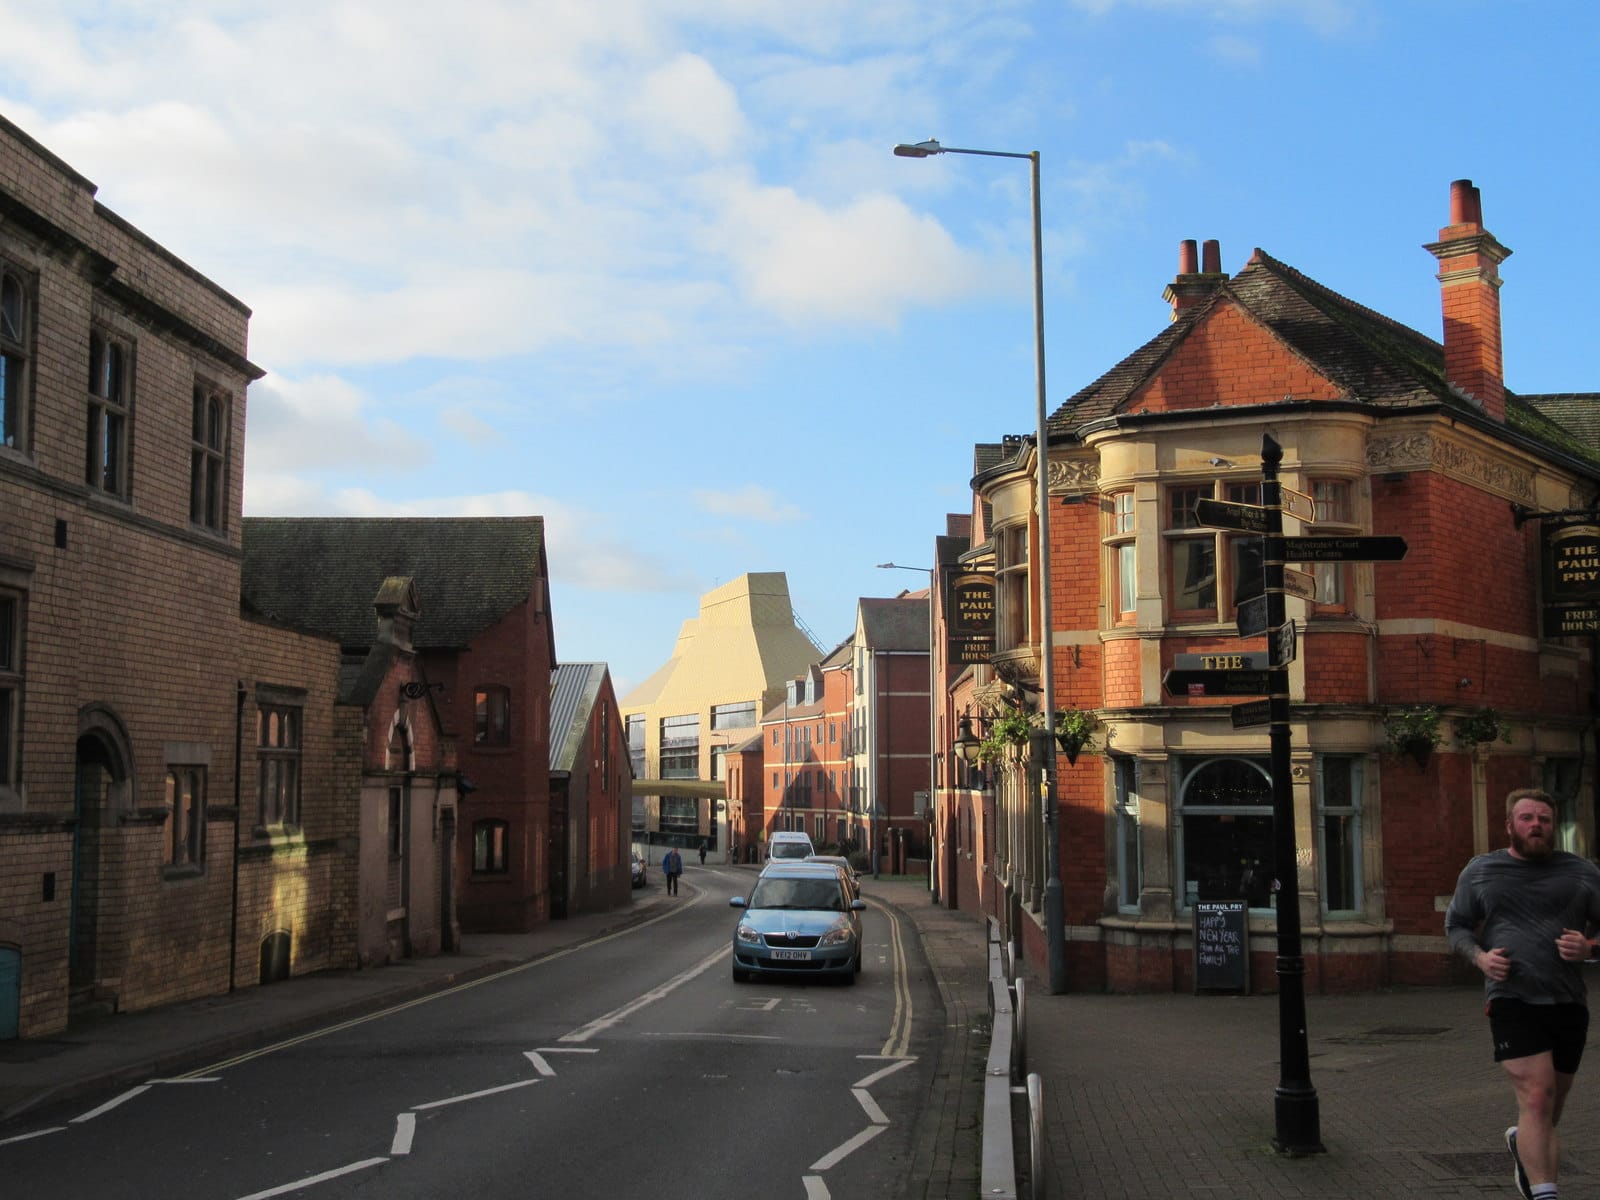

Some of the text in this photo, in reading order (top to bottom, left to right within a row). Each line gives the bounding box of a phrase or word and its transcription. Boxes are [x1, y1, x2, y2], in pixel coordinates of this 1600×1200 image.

[1335, 540, 1359, 549] Court
[1286, 550, 1314, 559] Health
[1563, 546, 1598, 556] THE
[1558, 558, 1600, 569] PAUL
[1562, 571, 1599, 582] PRY
[963, 591, 991, 599] THE
[959, 602, 995, 610] PAUL
[963, 612, 992, 621] PRY
[1565, 610, 1597, 620] FREE
[964, 643, 990, 651] FREE
[961, 652, 992, 661] HOUSE
[1200, 655, 1243, 670] THE
[1199, 916, 1226, 929] HAPPY
[1199, 929, 1240, 944] NEW YEAR
[775, 951, 791, 959] VE12
